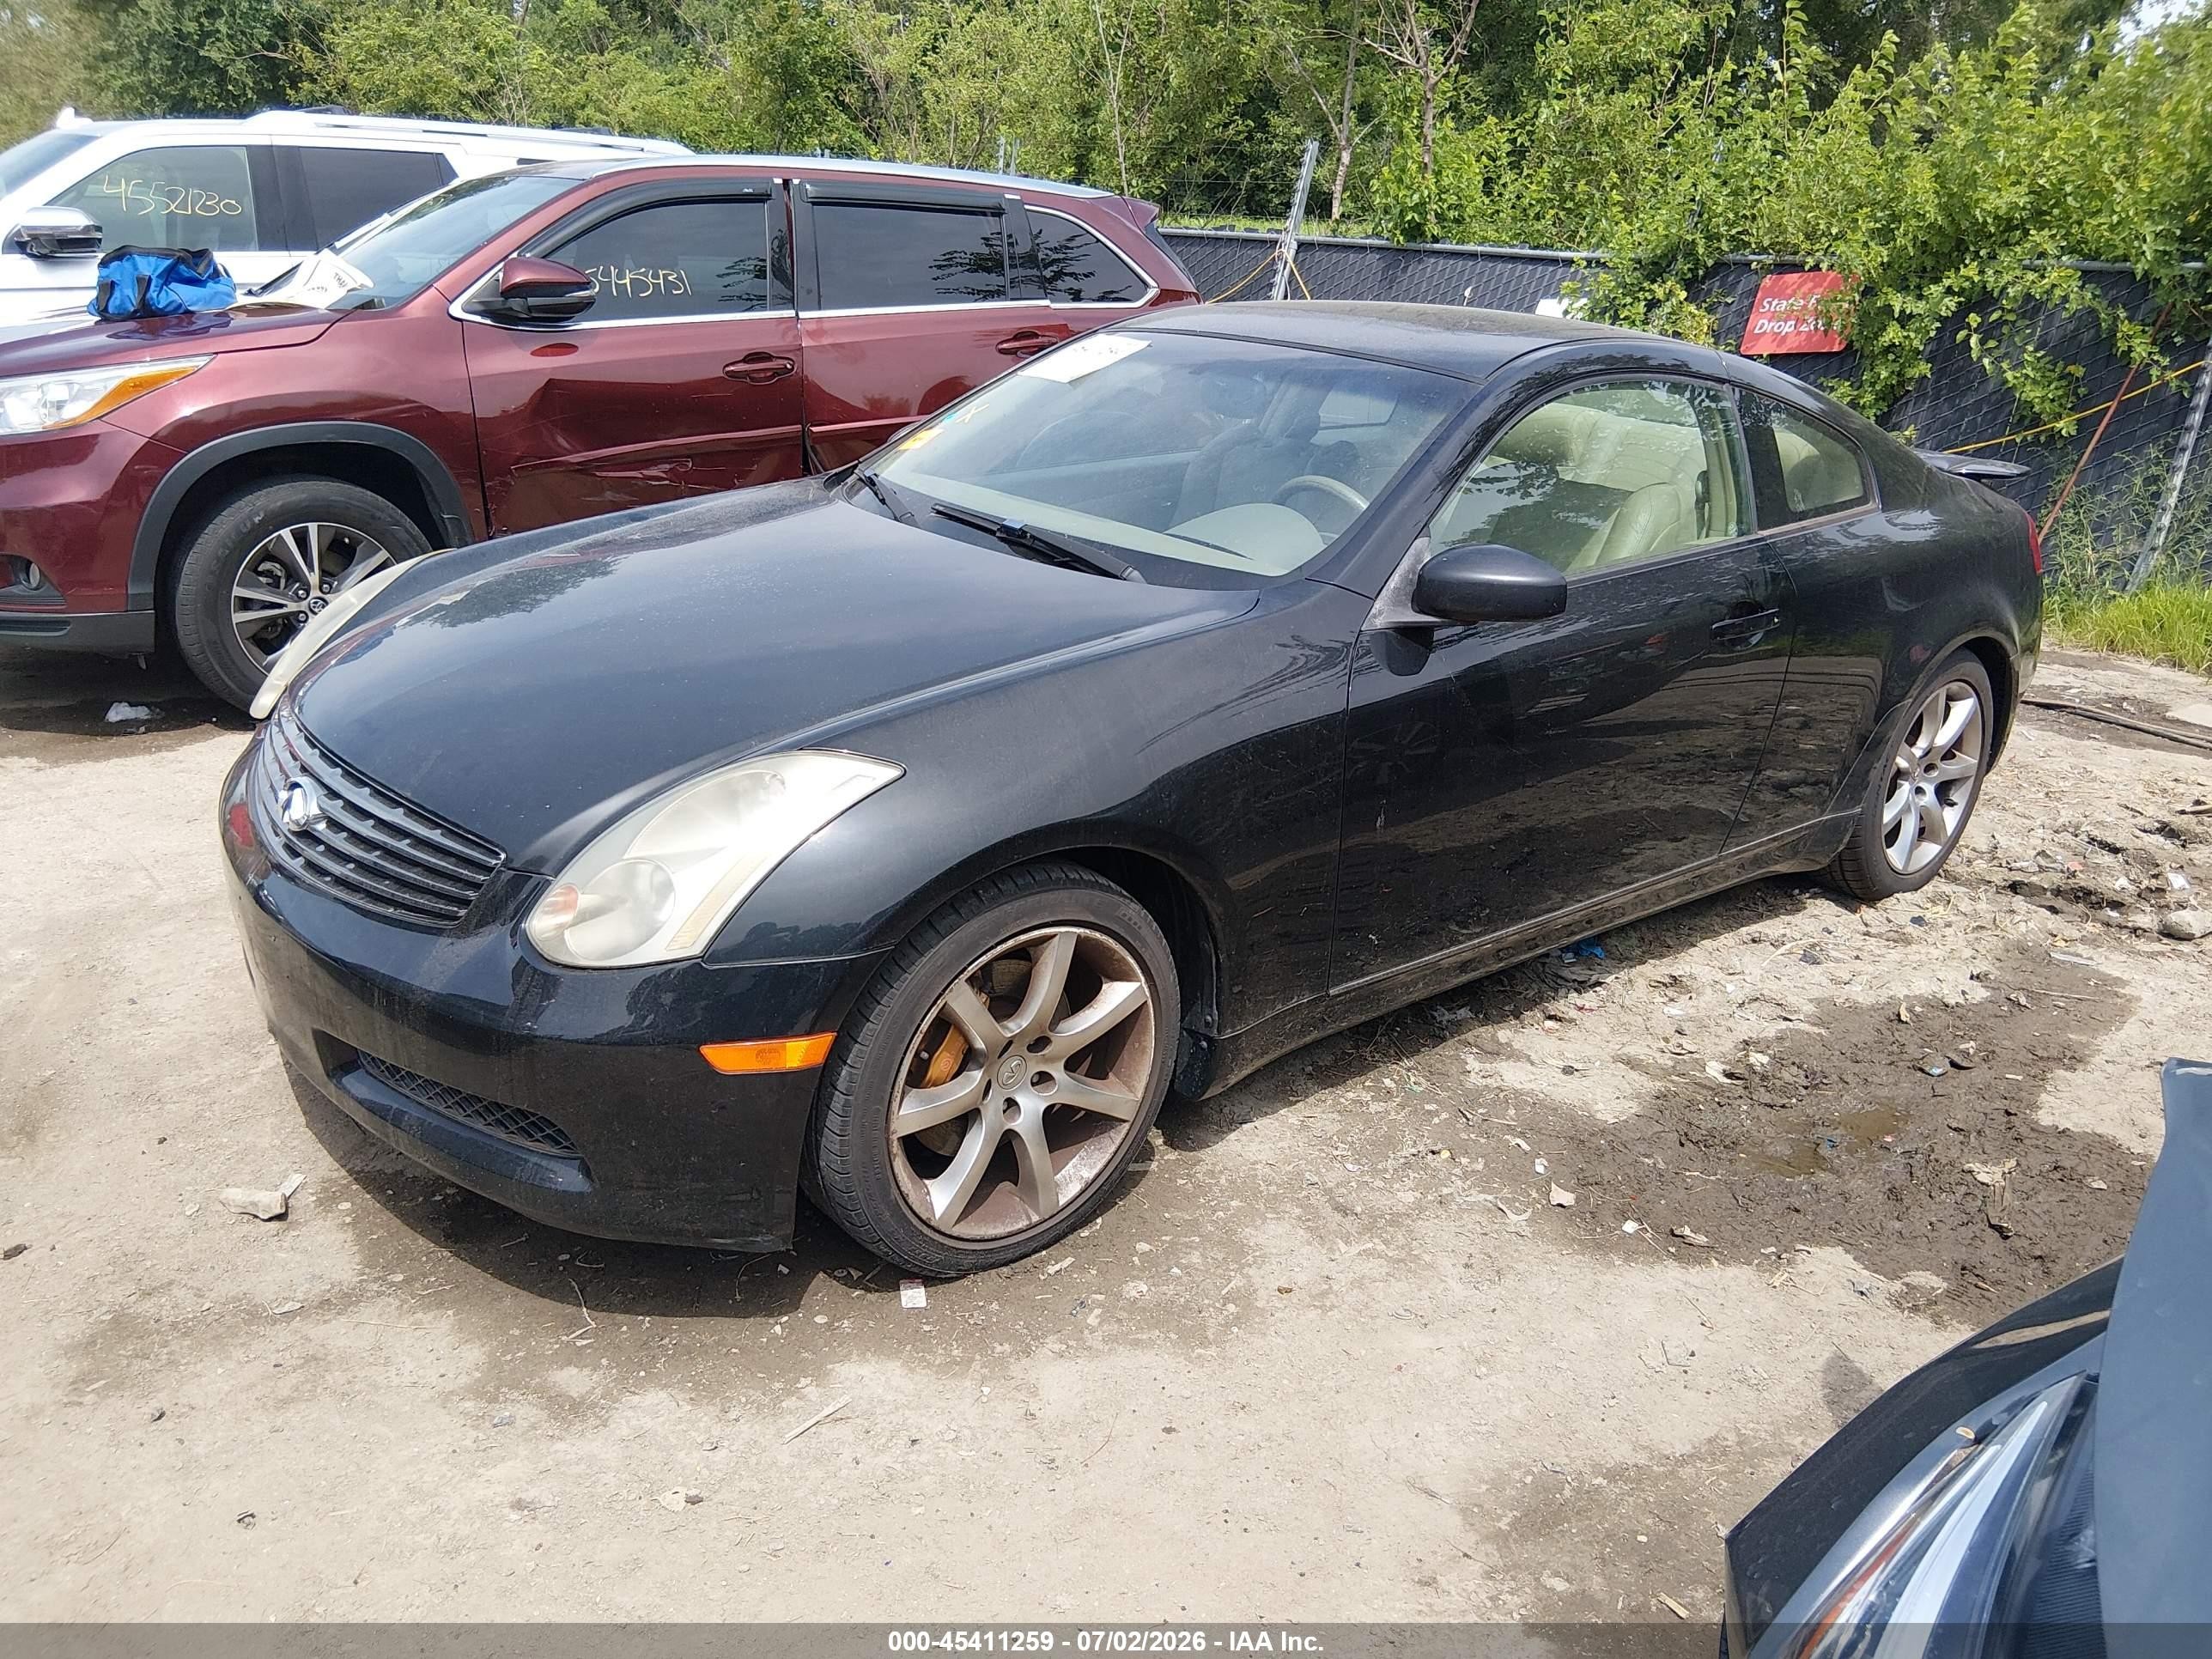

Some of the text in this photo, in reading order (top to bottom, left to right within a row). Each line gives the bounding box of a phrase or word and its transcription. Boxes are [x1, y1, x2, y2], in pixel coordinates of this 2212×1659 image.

[103, 175, 241, 216] 45521230
[1759, 295, 1804, 313] State
[1753, 319, 1796, 336] Drop
